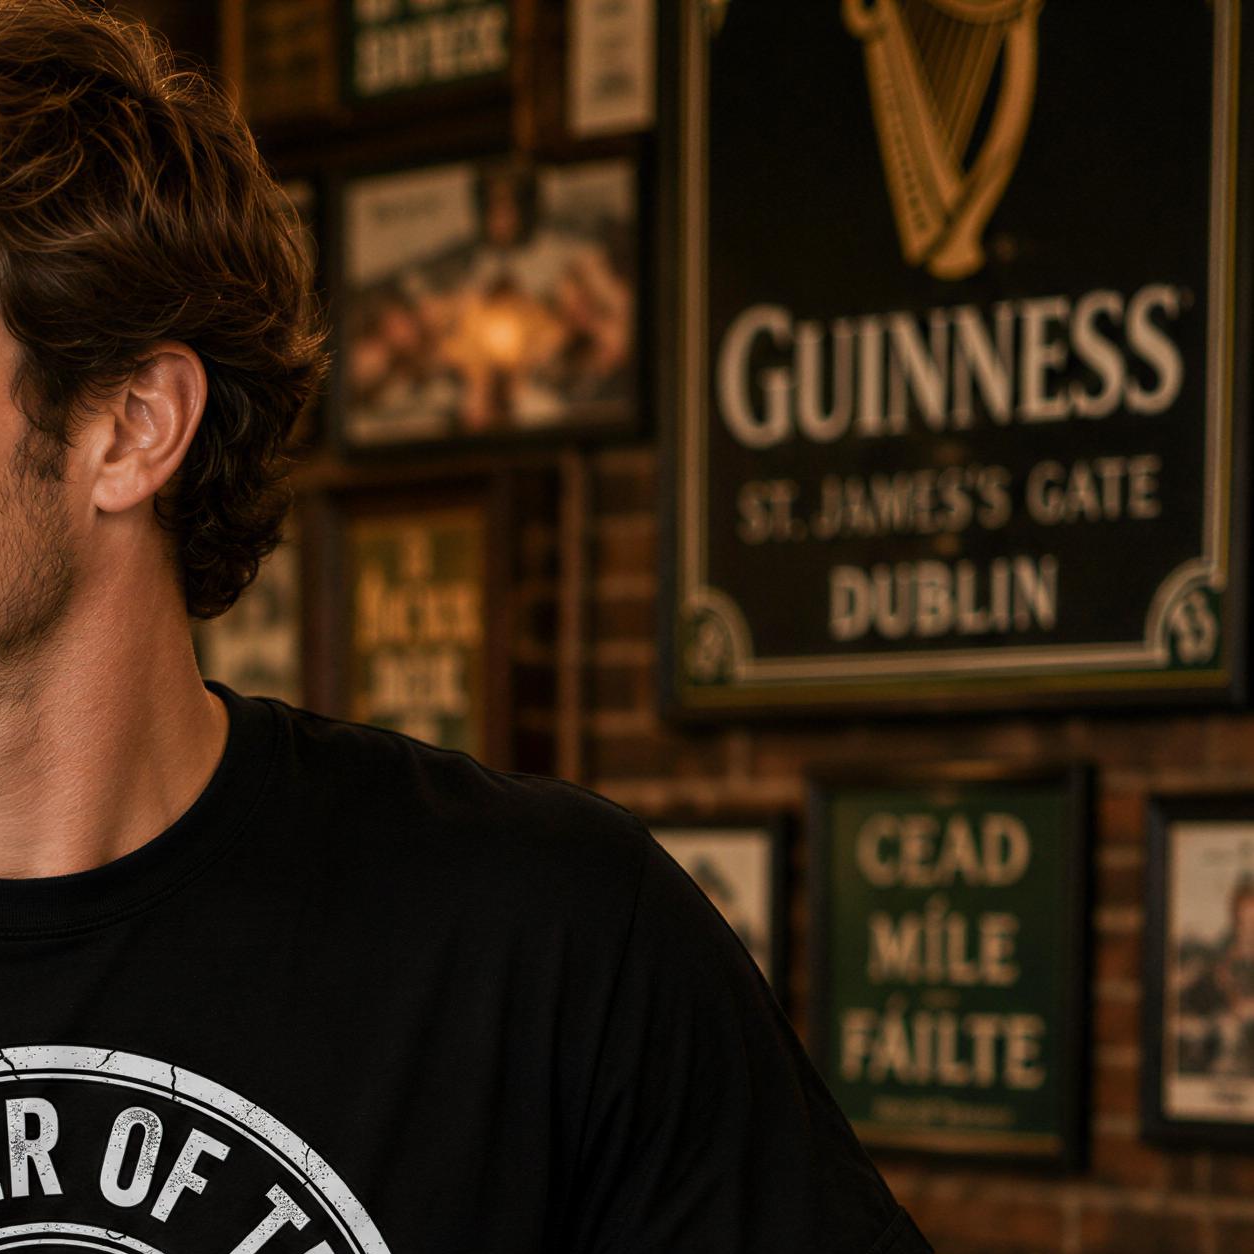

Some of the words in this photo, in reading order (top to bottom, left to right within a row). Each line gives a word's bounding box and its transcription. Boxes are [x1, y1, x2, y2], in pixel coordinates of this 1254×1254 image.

[716, 283, 1186, 449] GUINNESS
[1025, 453, 1161, 526] GATE
[828, 554, 1058, 641] DUBLIN
[99, 1106, 232, 1224] OF
